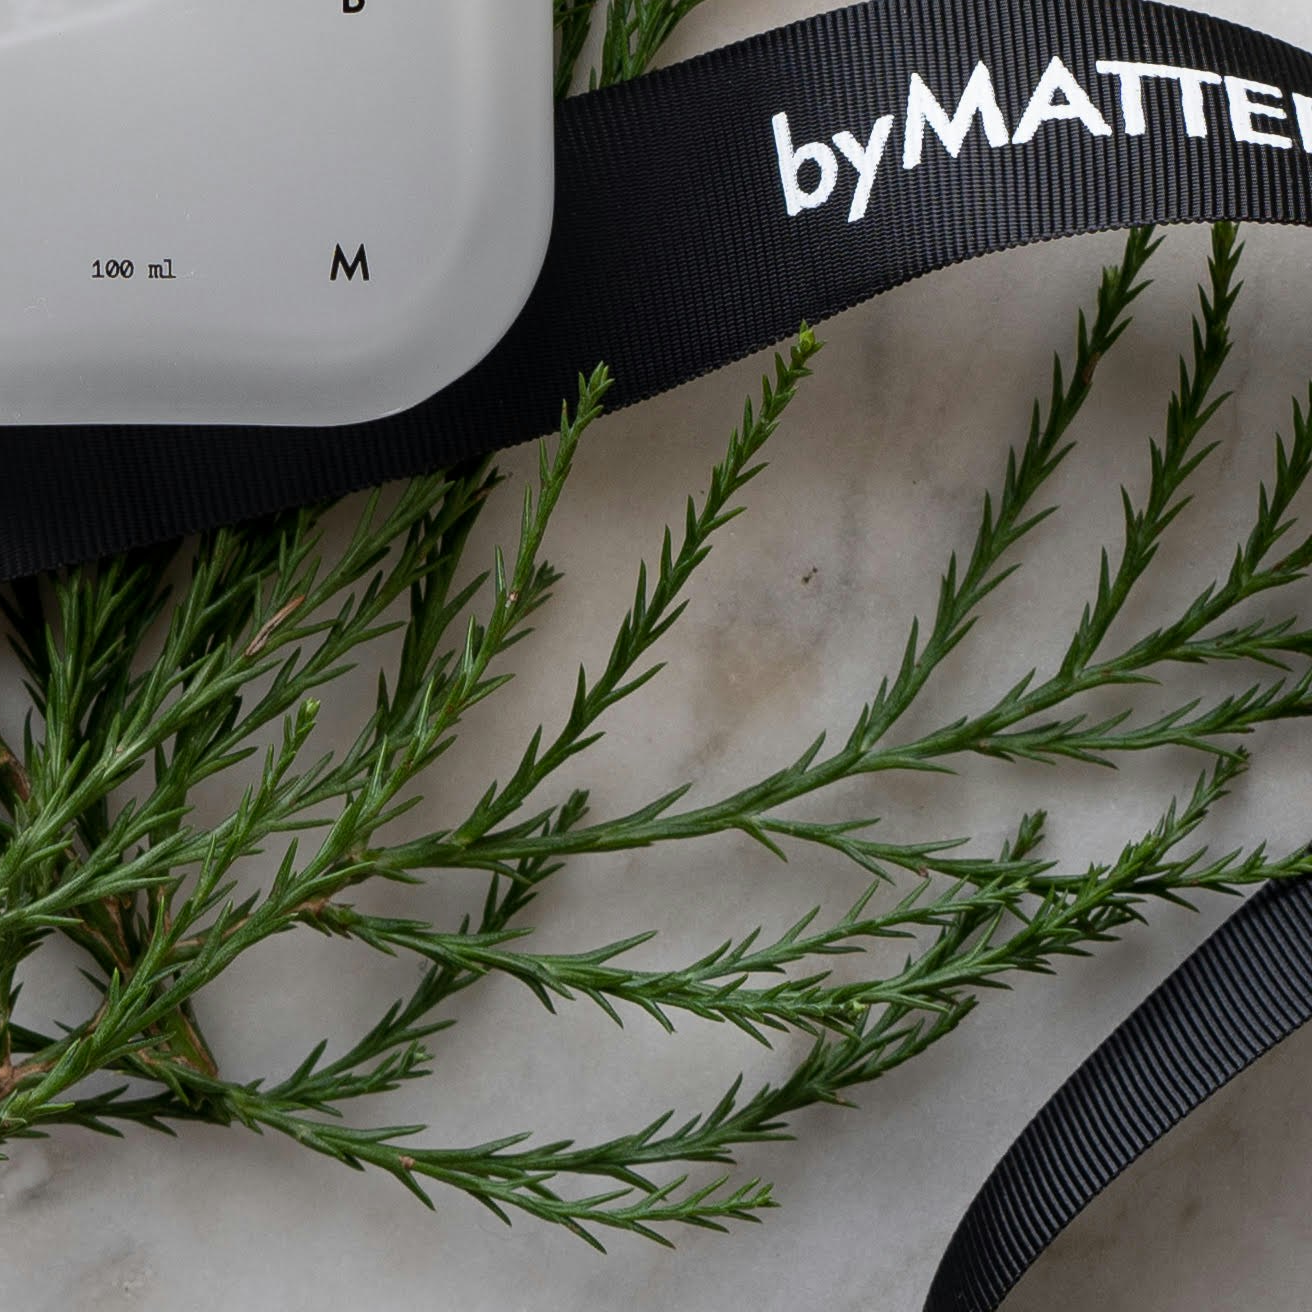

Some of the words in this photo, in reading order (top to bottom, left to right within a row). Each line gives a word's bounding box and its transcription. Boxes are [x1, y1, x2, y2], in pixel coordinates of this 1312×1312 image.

[91, 259, 135, 279] 100
[147, 258, 178, 279] ml
[329, 243, 370, 282] M
